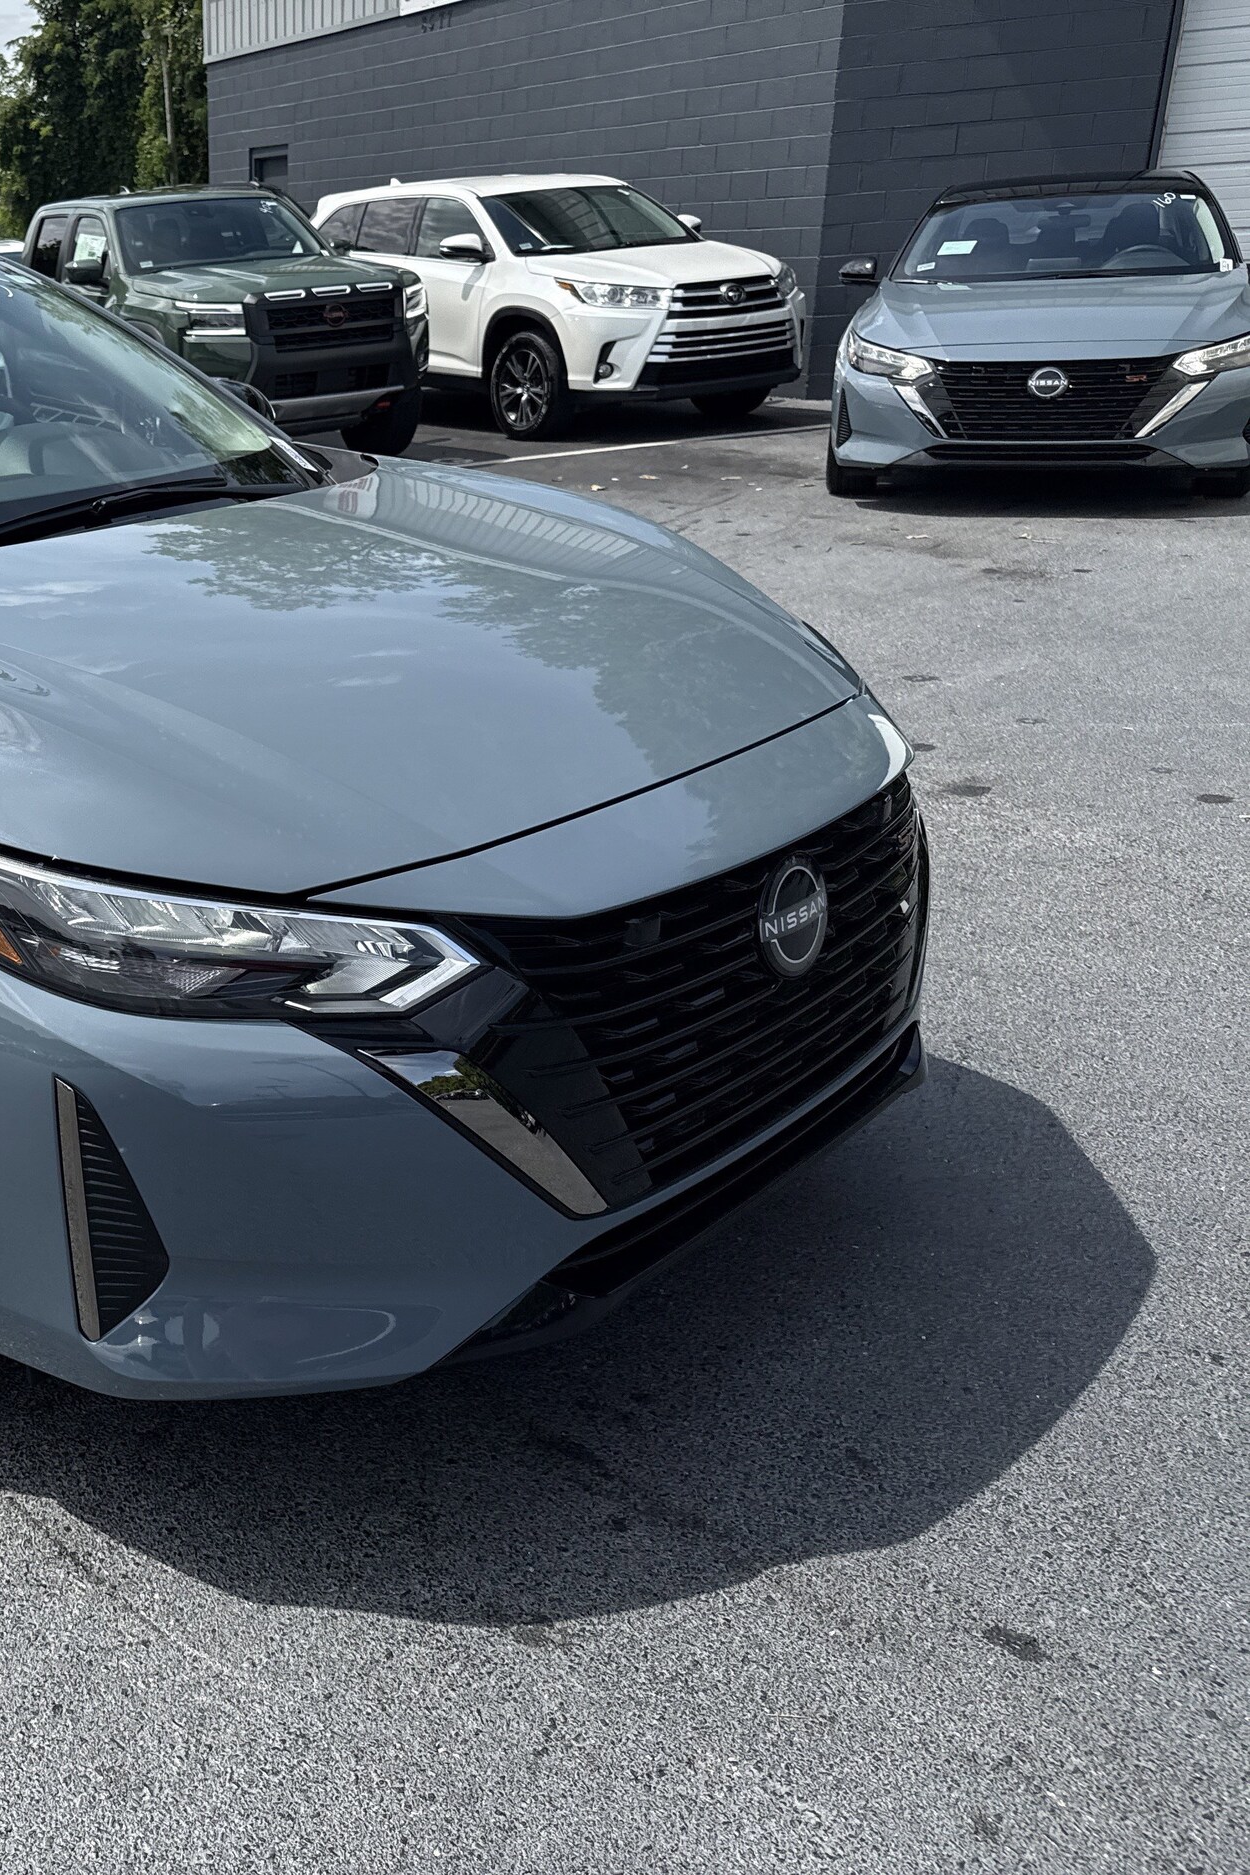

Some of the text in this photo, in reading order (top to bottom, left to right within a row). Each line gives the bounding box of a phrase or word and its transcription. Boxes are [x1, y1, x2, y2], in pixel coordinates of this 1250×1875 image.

[1152, 192, 1177, 208] 160
[1125, 375, 1148, 383] SR
[764, 896, 827, 938] NISSAN
